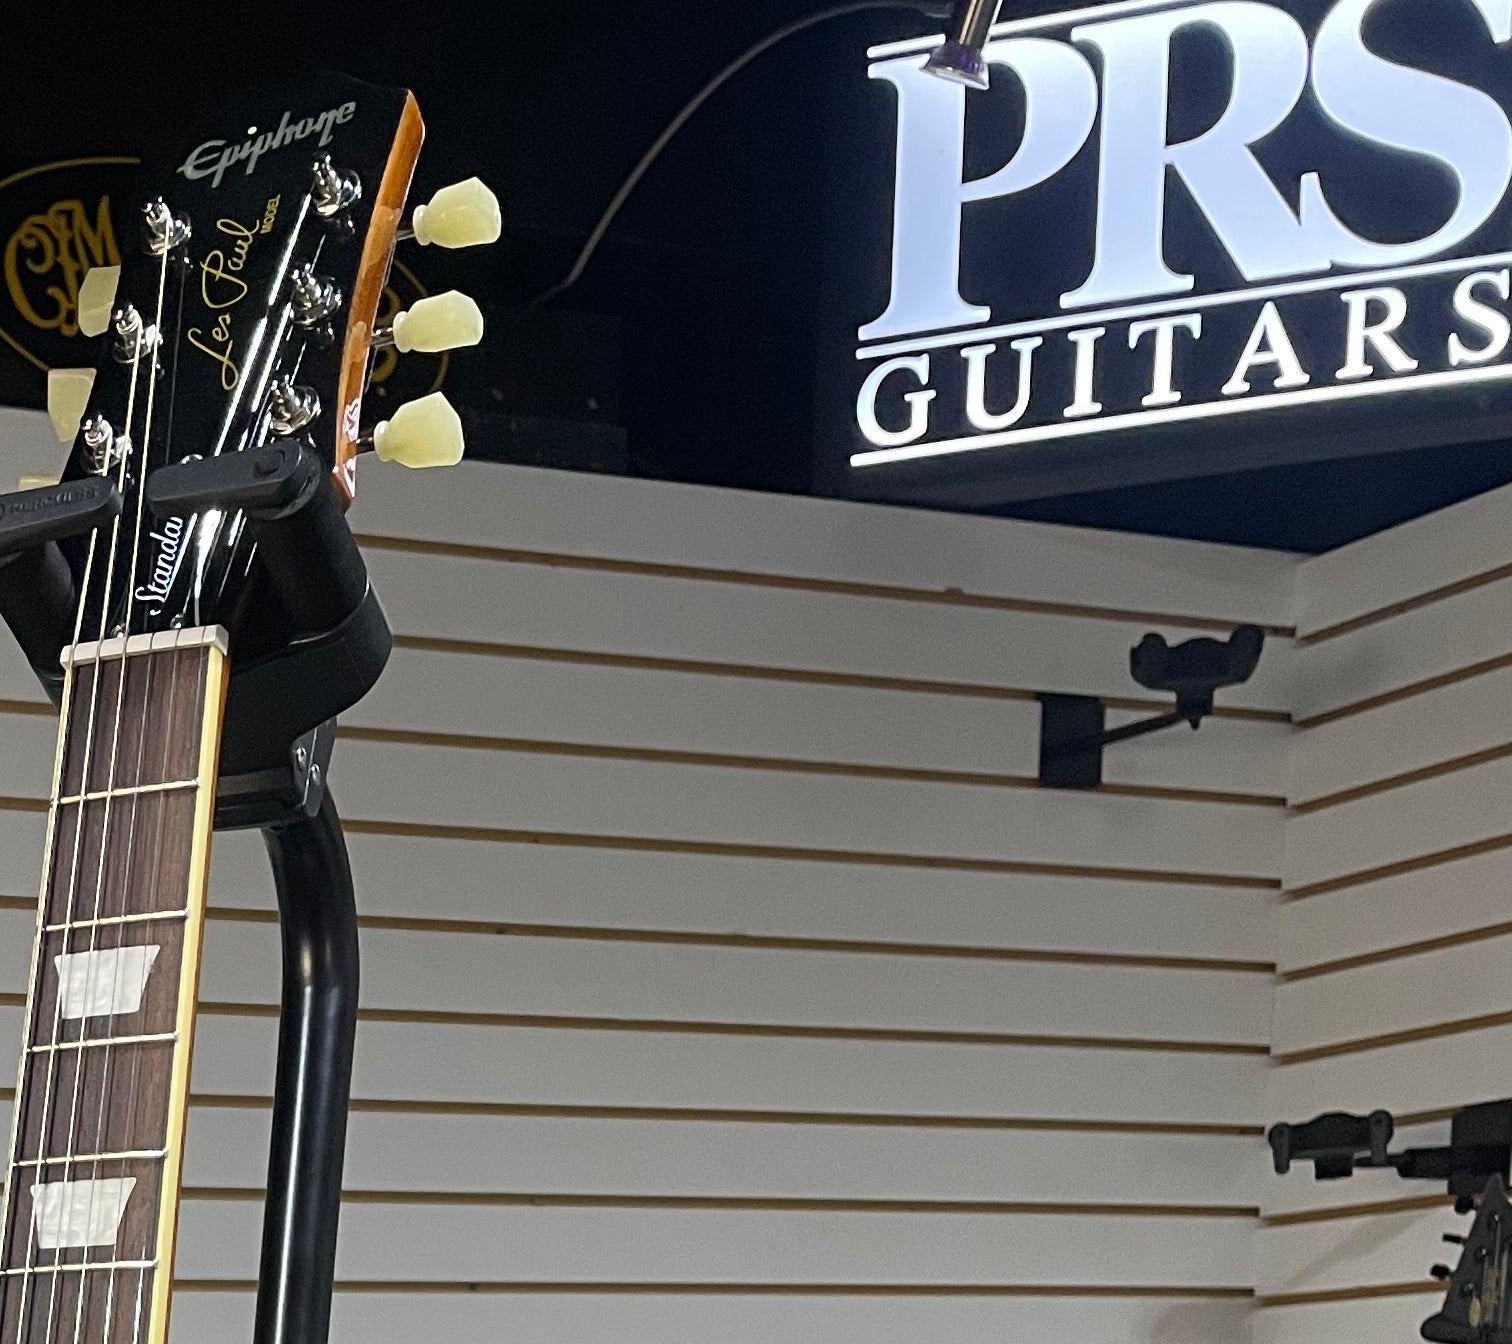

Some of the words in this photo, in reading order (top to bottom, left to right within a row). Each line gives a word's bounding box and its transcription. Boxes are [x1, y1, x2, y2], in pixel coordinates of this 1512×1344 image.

[177, 101, 356, 188] Epiphone
[857, 0, 1512, 341] PRS
[260, 194, 281, 234] MODEL
[200, 219, 260, 309] Paul
[188, 312, 238, 391] Les
[855, 269, 1511, 447] GUITARS
